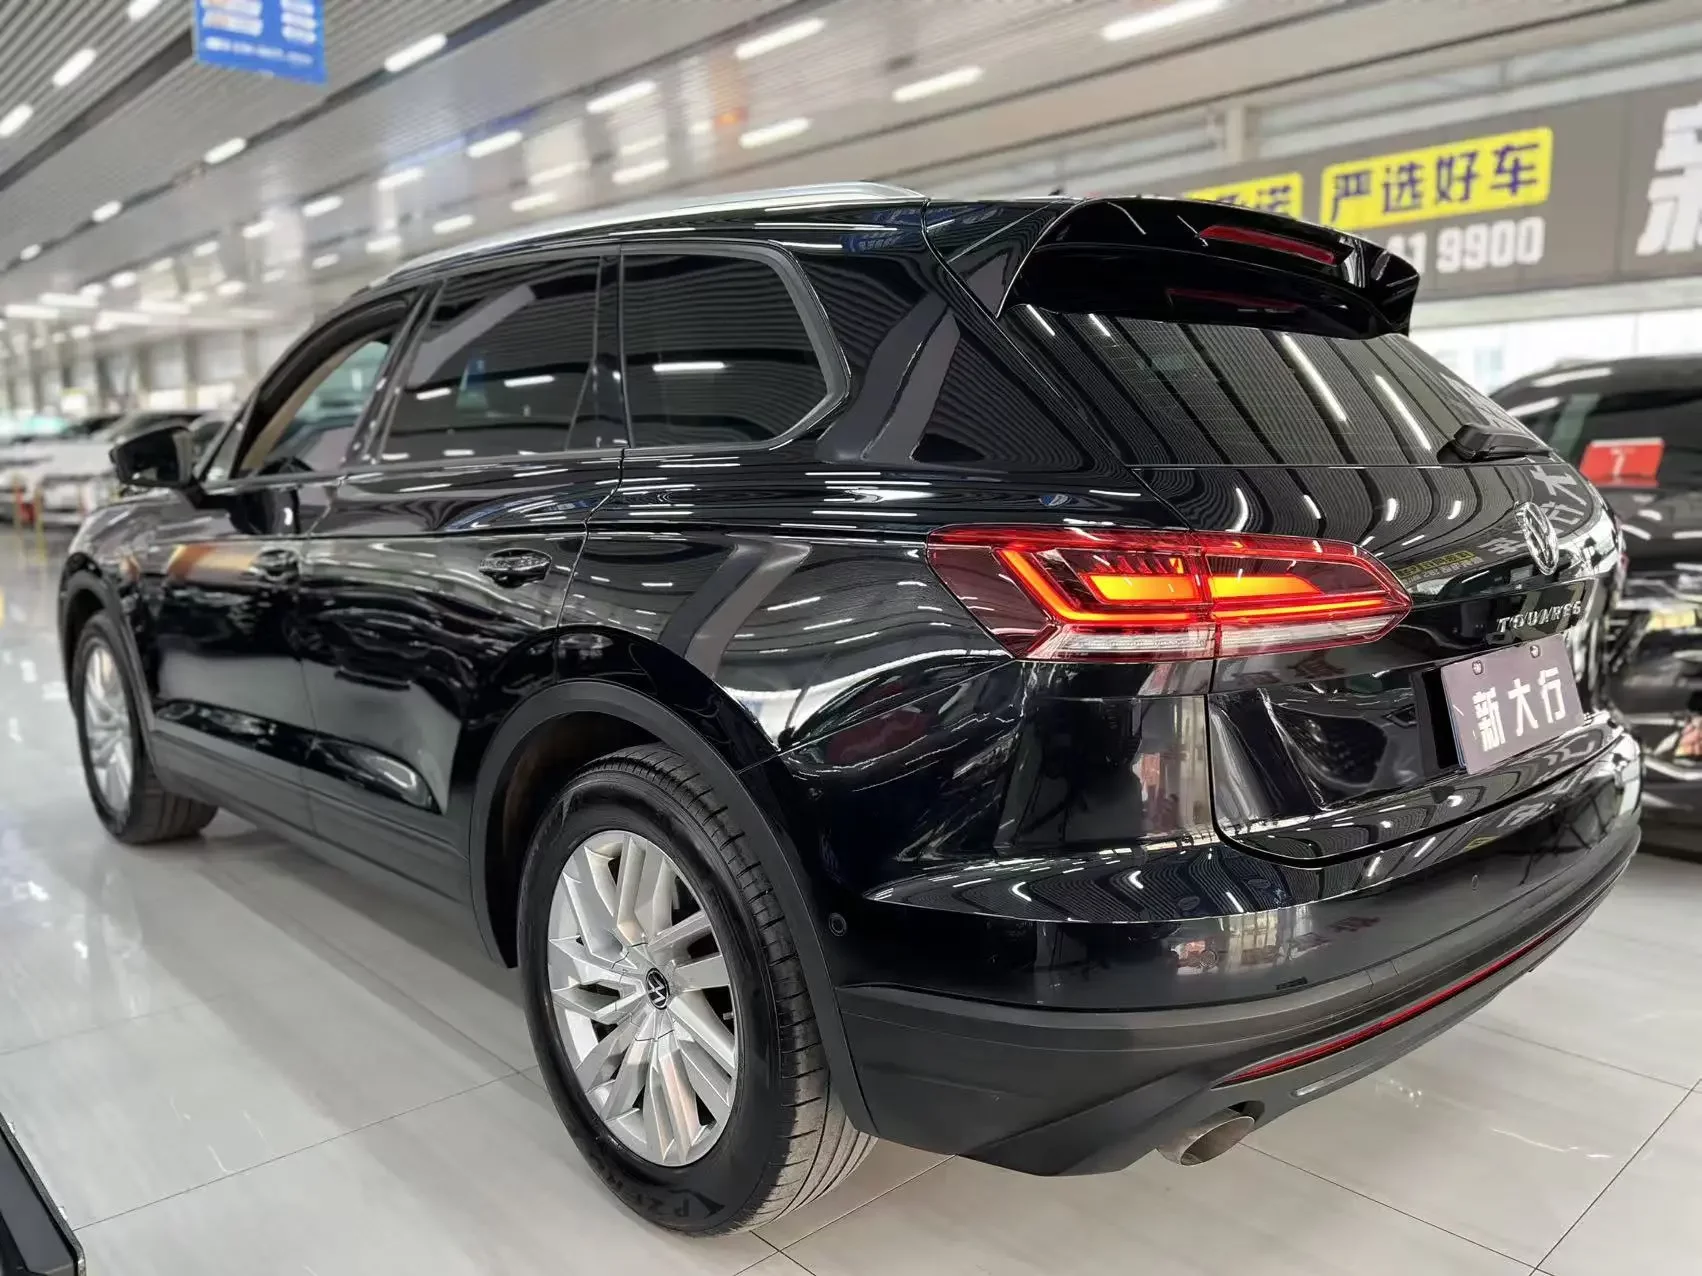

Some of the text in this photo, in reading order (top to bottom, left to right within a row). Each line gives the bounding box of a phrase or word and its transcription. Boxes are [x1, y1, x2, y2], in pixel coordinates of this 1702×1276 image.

[1331, 143, 1540, 222] 严选好车
[1436, 216, 1546, 274] 9900
[1497, 601, 1582, 633] TOUAREG
[1472, 666, 1567, 752] 新大行
